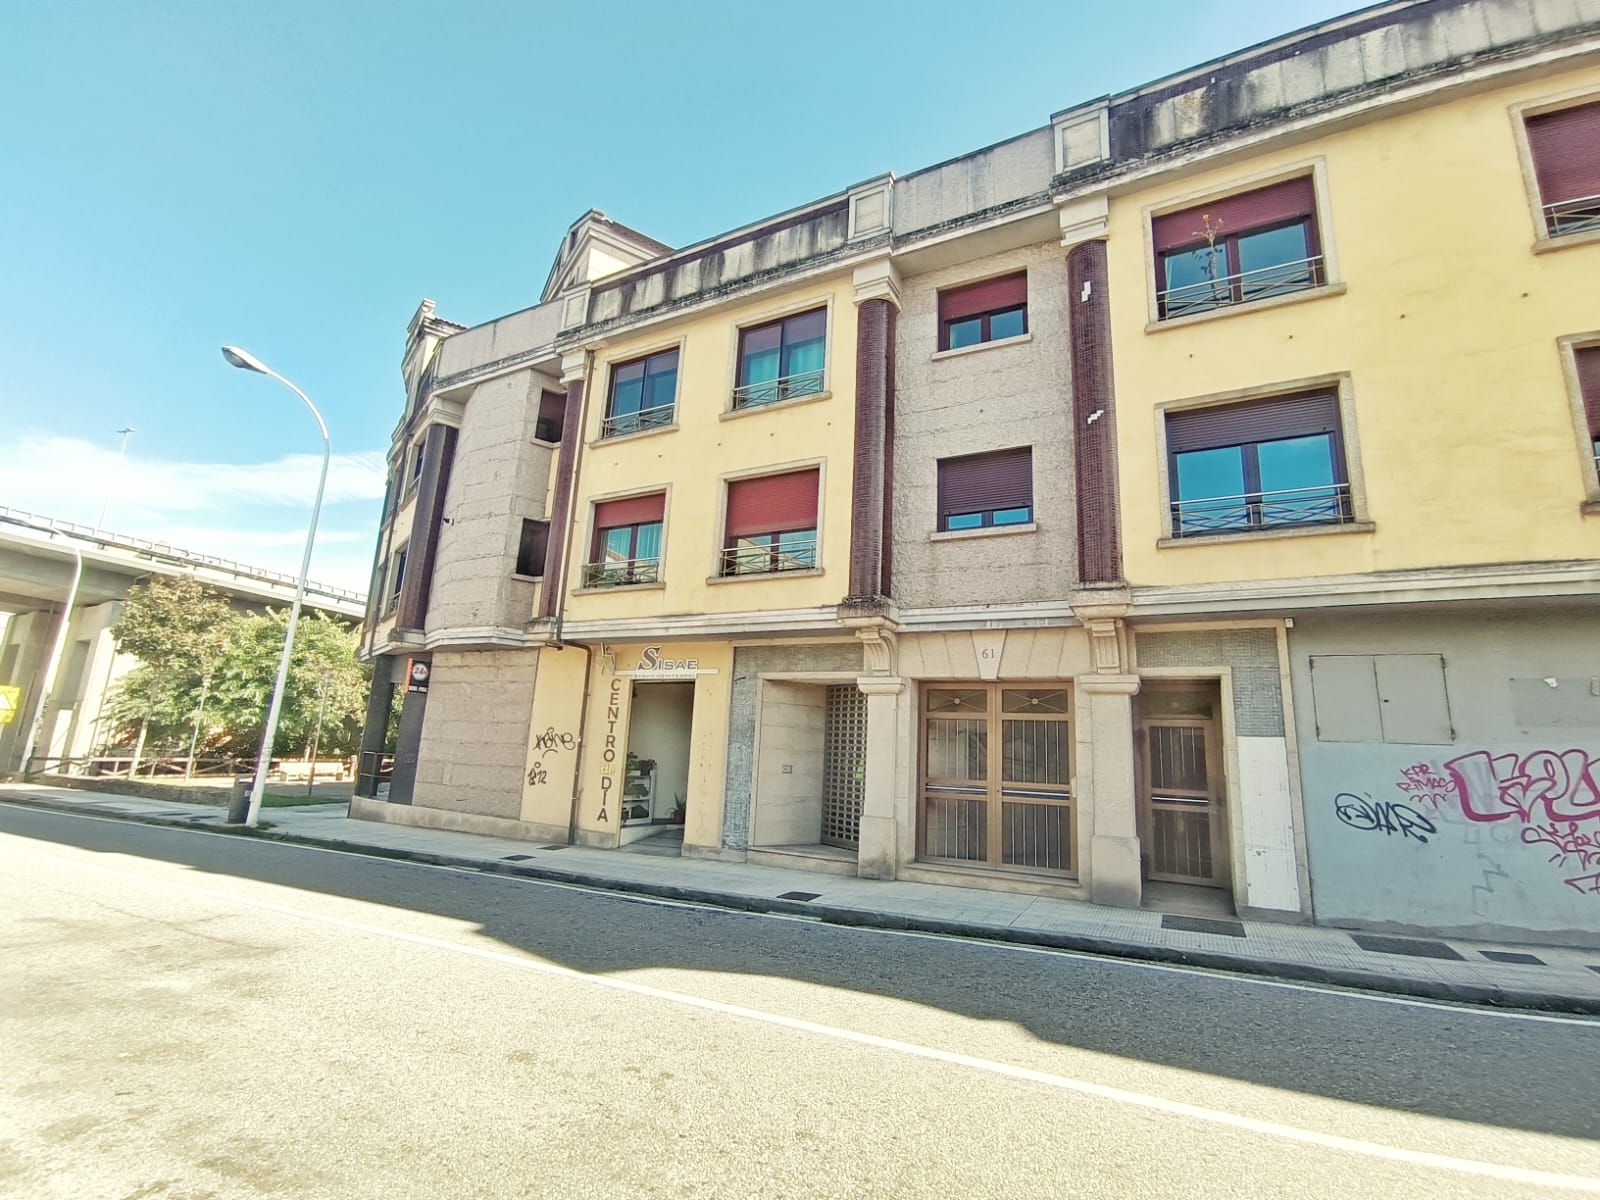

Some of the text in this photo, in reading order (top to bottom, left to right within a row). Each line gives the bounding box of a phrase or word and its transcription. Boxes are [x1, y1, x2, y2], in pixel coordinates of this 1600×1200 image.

[637, 646, 698, 671] SISAE
[981, 648, 995, 659] 61
[603, 678, 622, 763] CENTRO
